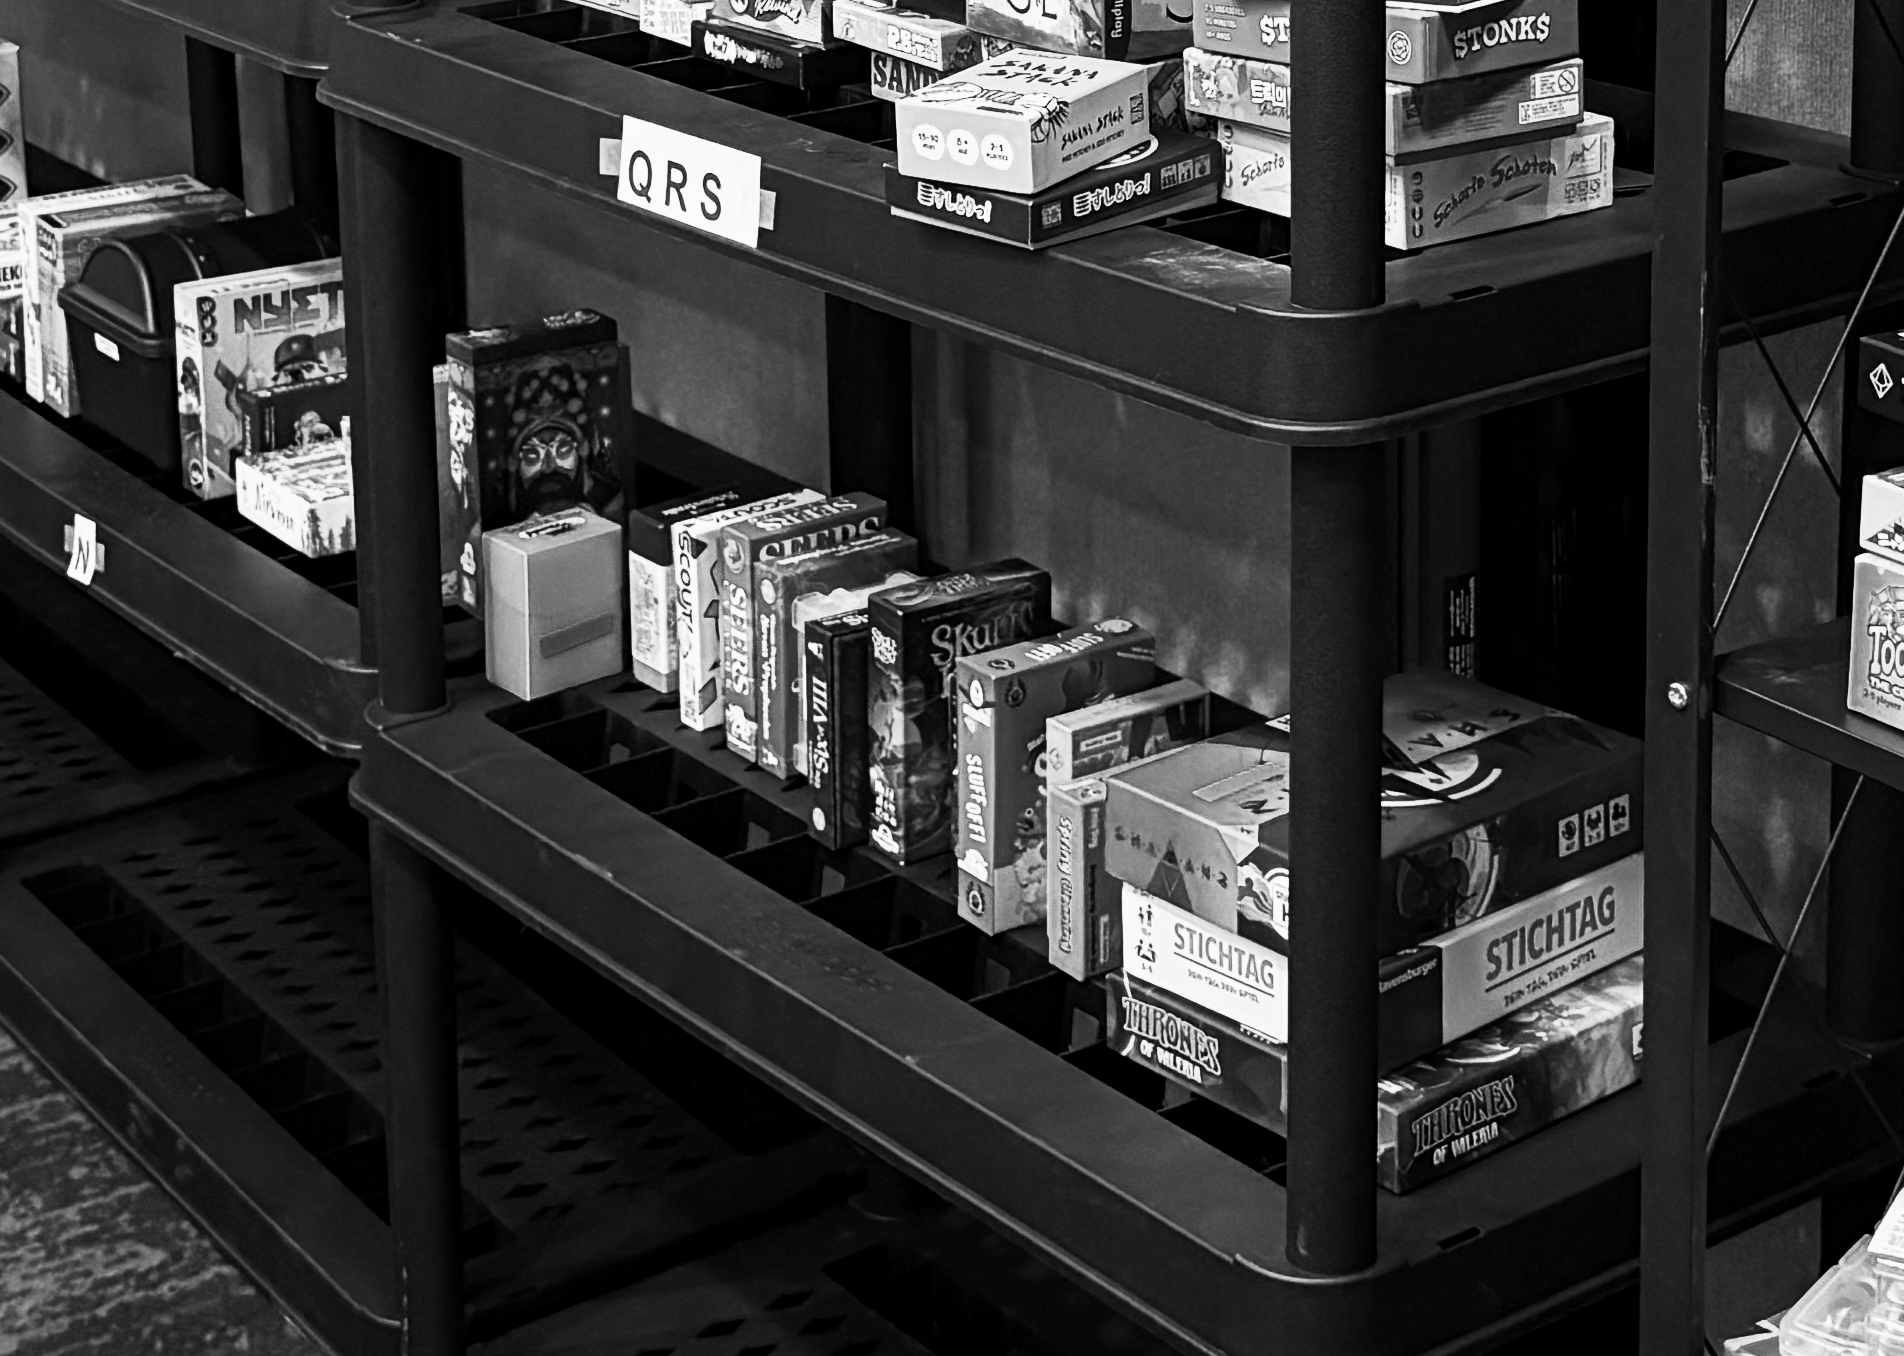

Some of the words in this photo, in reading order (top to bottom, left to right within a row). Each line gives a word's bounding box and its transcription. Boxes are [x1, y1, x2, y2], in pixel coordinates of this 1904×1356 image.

[74, 536, 91, 575] N
[1173, 922, 1275, 990] STICHTAG
[1485, 885, 1616, 982] STICHTAG
[1121, 996, 1221, 1076] THRONES
